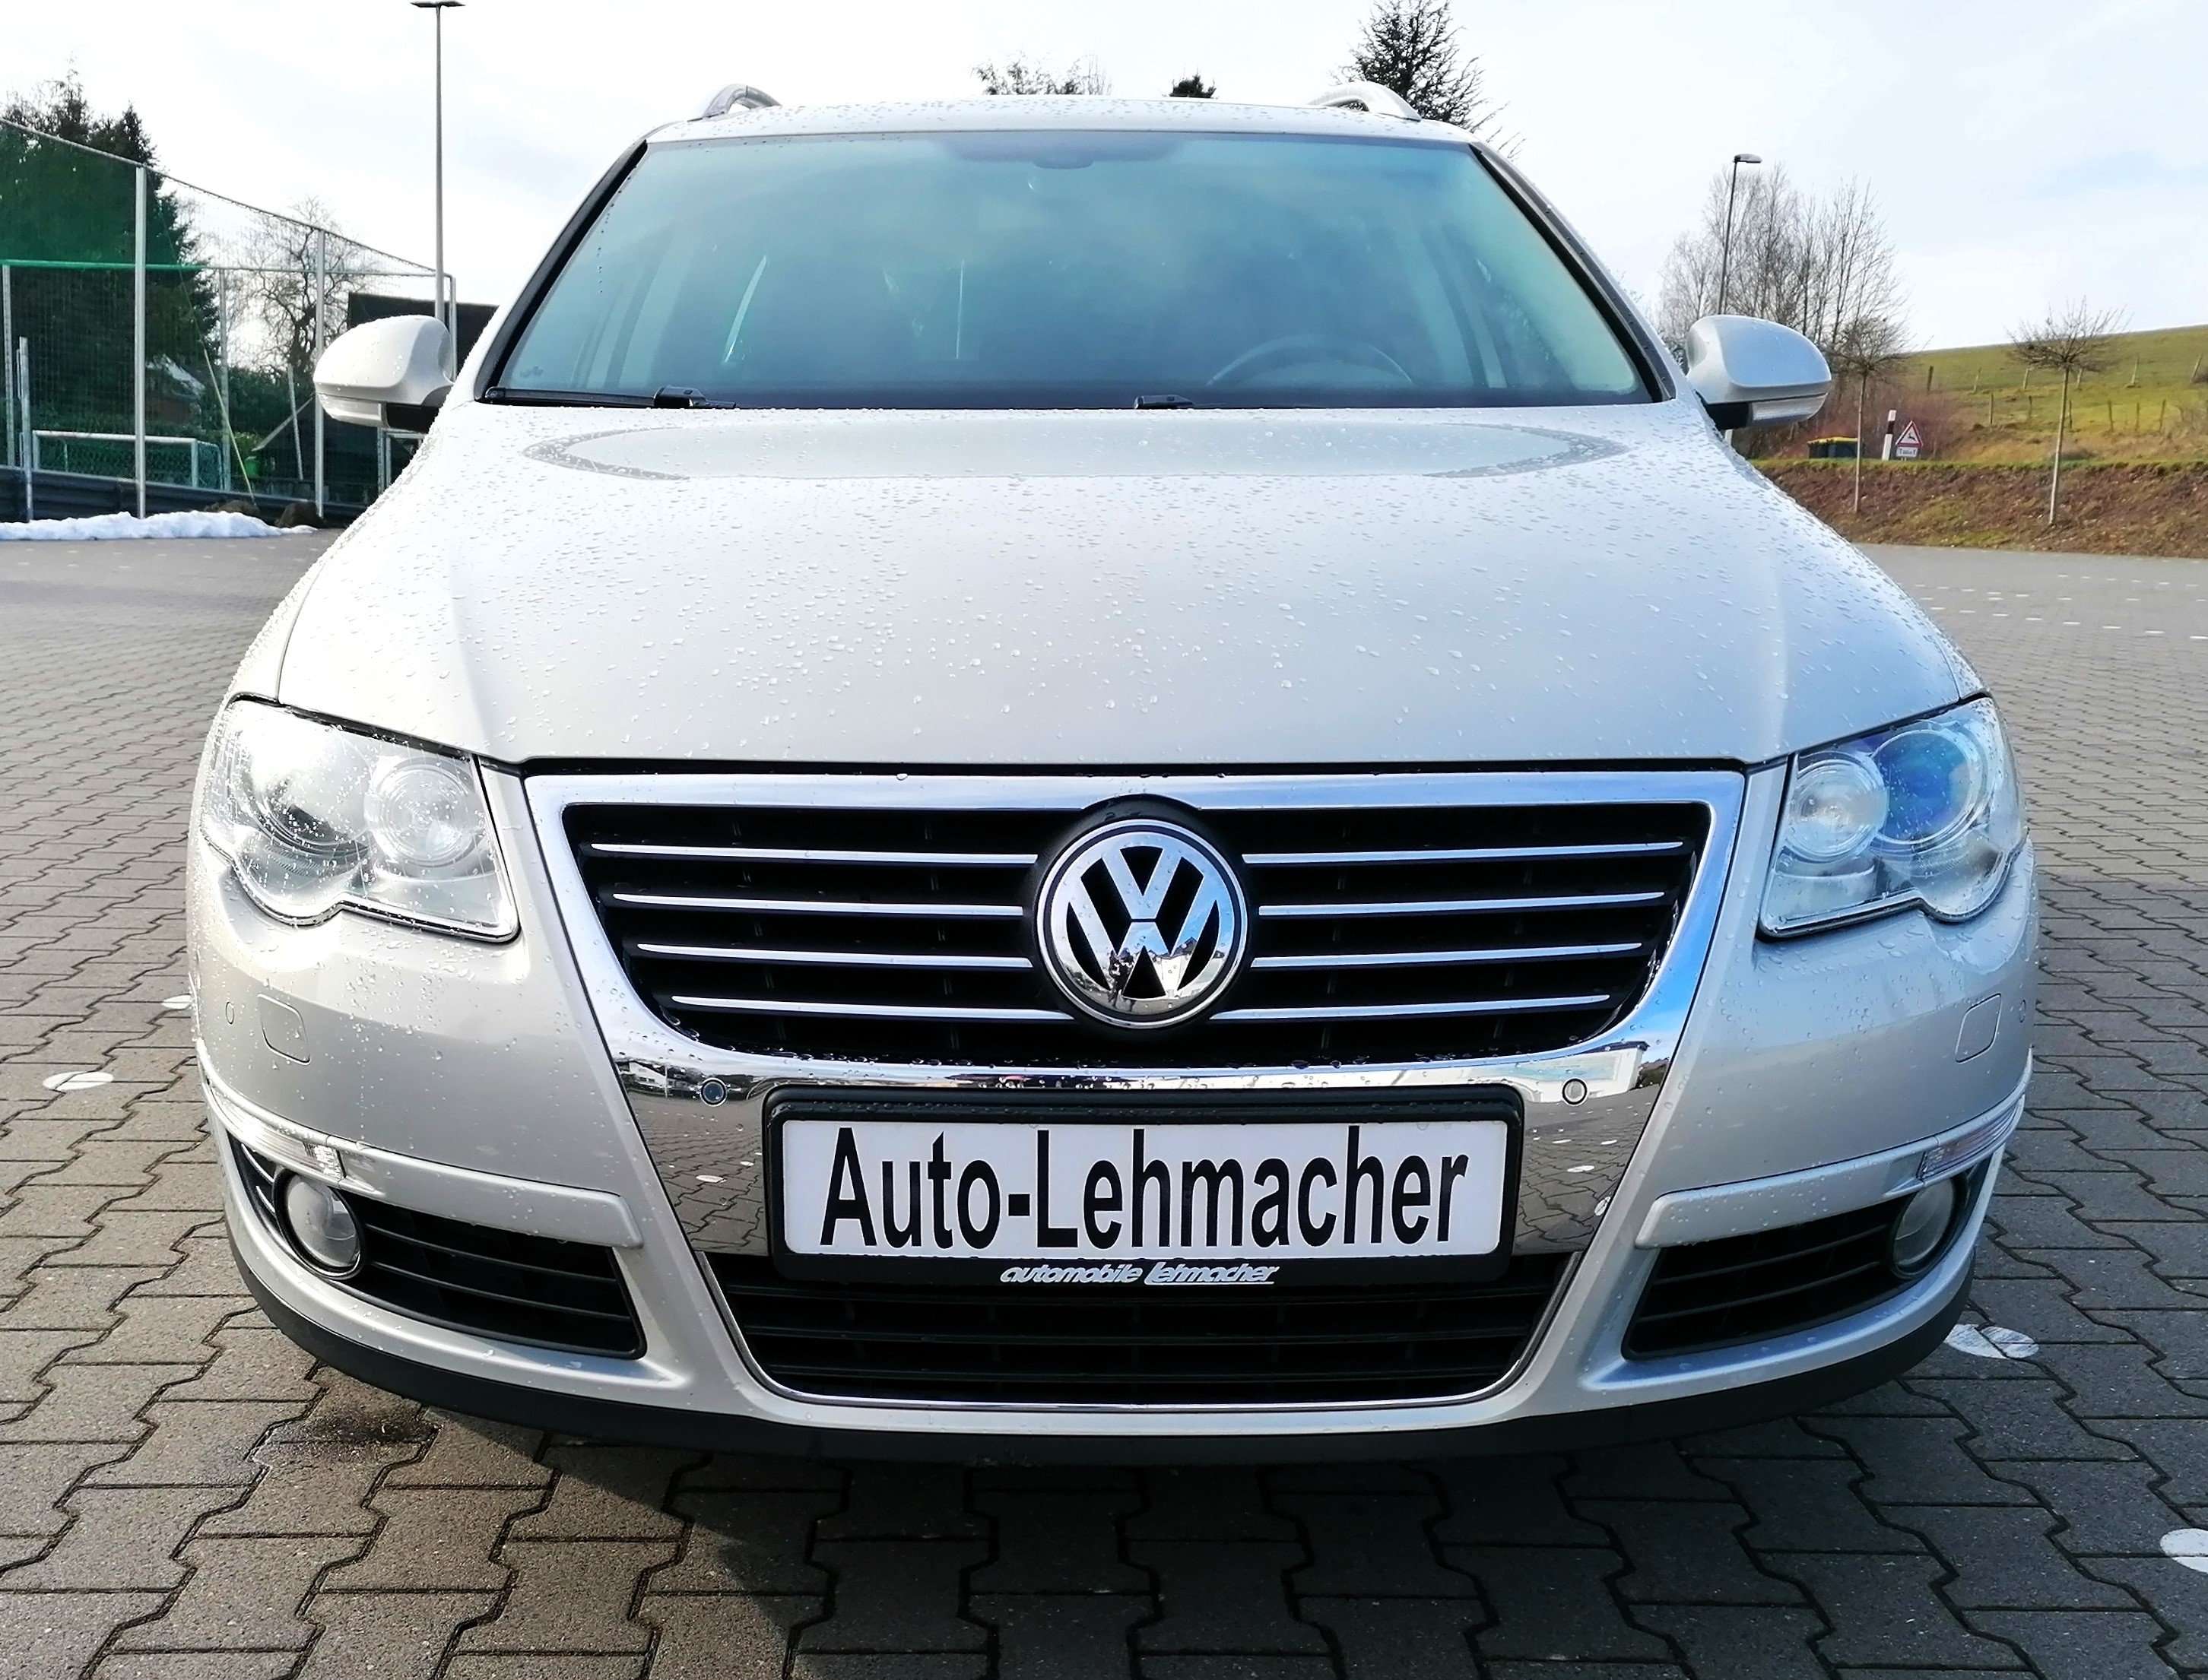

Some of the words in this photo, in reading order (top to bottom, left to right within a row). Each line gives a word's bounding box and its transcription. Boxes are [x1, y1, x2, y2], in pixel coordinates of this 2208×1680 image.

[1049, 829, 1236, 1017] VW
[820, 1125, 1469, 1250] Auto-Lehmacher
[999, 1263, 1144, 1283] automobile
